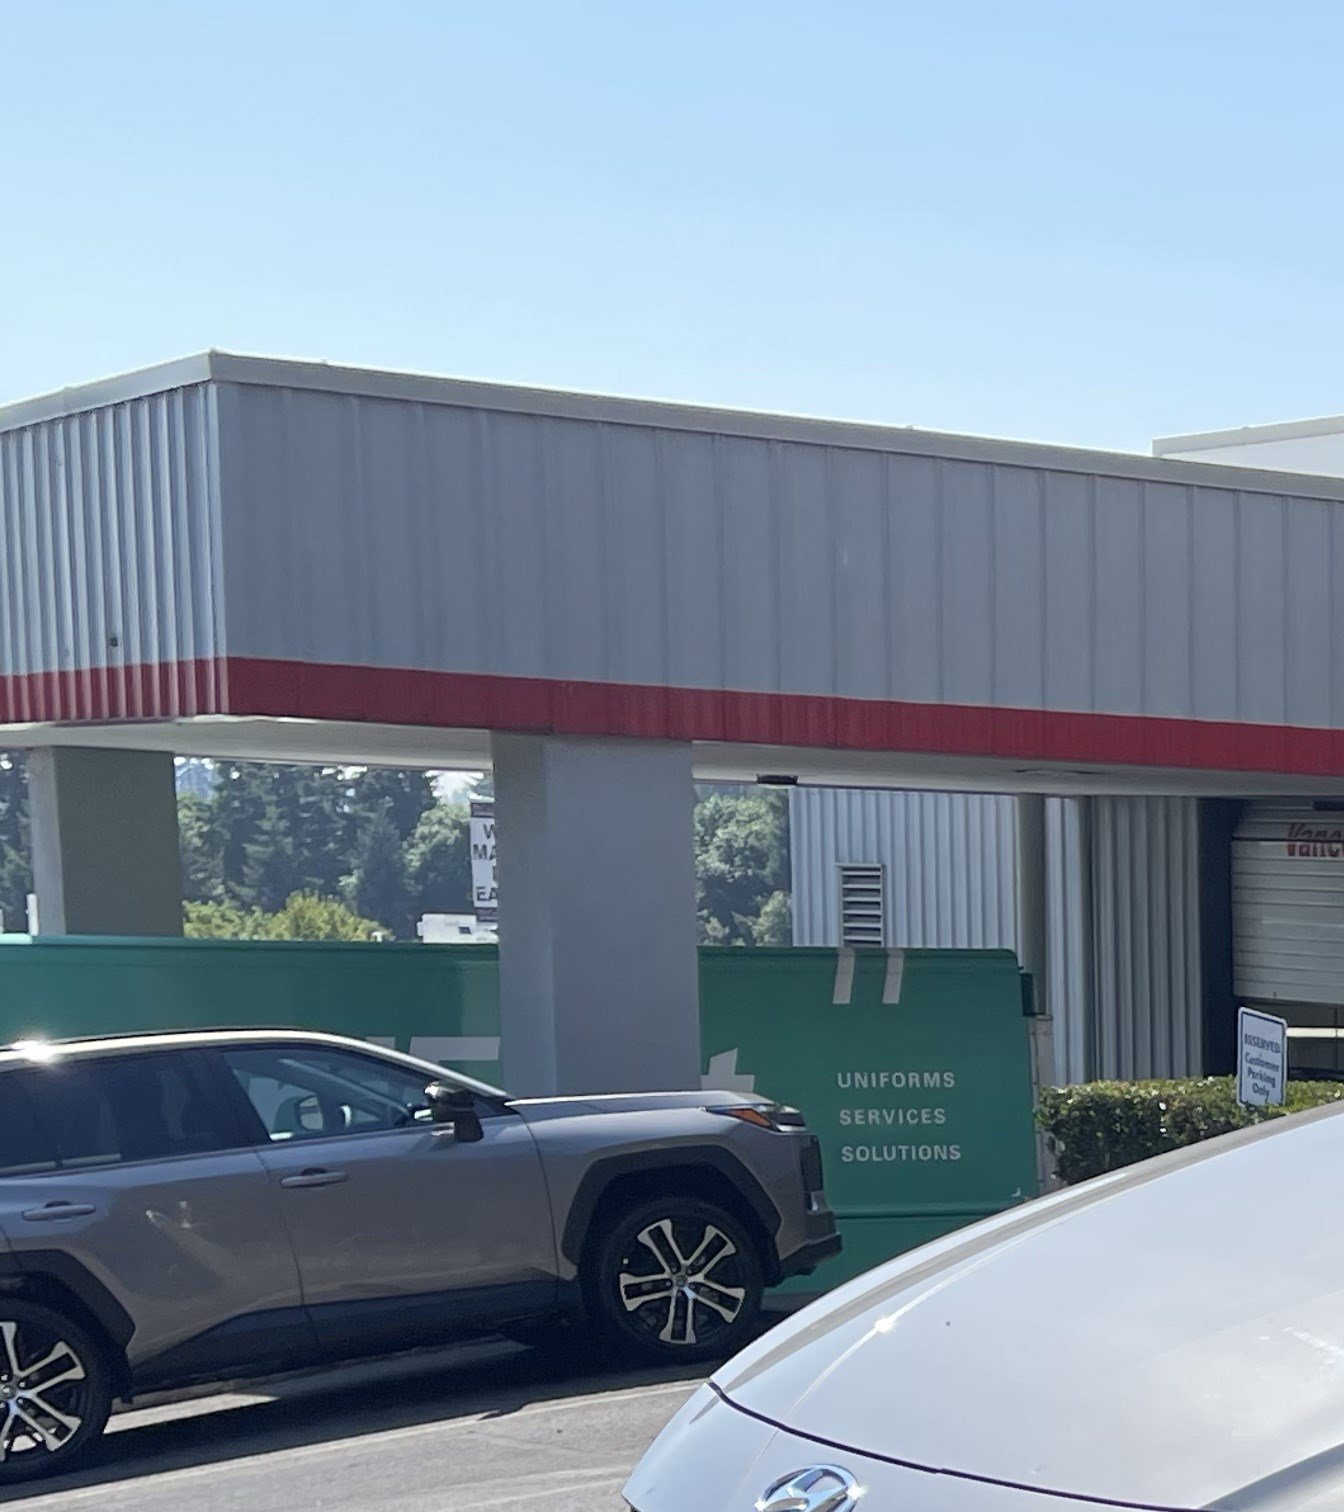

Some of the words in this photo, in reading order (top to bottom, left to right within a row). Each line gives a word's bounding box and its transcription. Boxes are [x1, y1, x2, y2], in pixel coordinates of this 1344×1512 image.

[473, 843, 496, 860] MA
[476, 887, 497, 901] EA
[1244, 1033, 1281, 1054] RESERVED
[837, 1072, 955, 1088] UNIFORMS
[1247, 1067, 1276, 1088] Parking
[839, 1108, 946, 1125] SERVICES
[841, 1144, 961, 1163] SOLUTIONS
